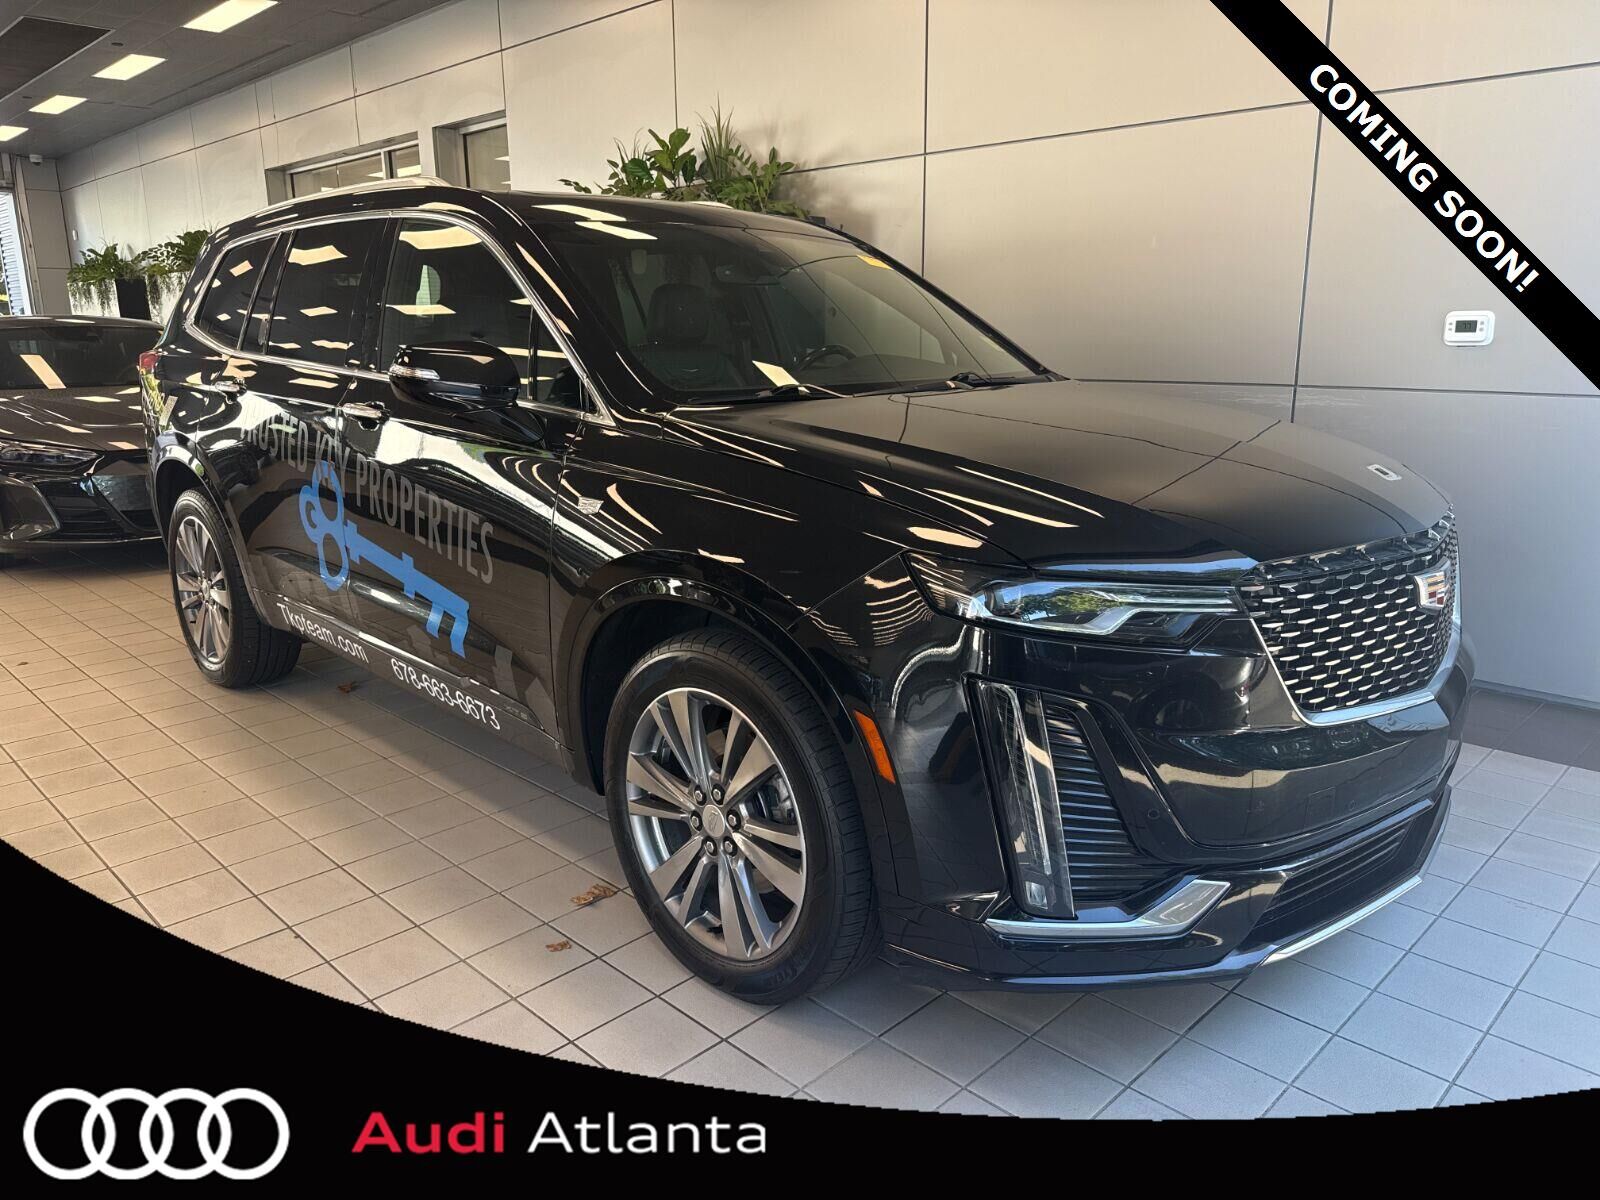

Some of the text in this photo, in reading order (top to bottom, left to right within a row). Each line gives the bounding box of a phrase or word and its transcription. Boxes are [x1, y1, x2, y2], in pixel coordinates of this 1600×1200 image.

[240, 409, 309, 473] USTED
[355, 452, 494, 584] PROPERTIES
[276, 602, 370, 664] Tkpteam.com
[390, 657, 501, 731] 678-663-6673
